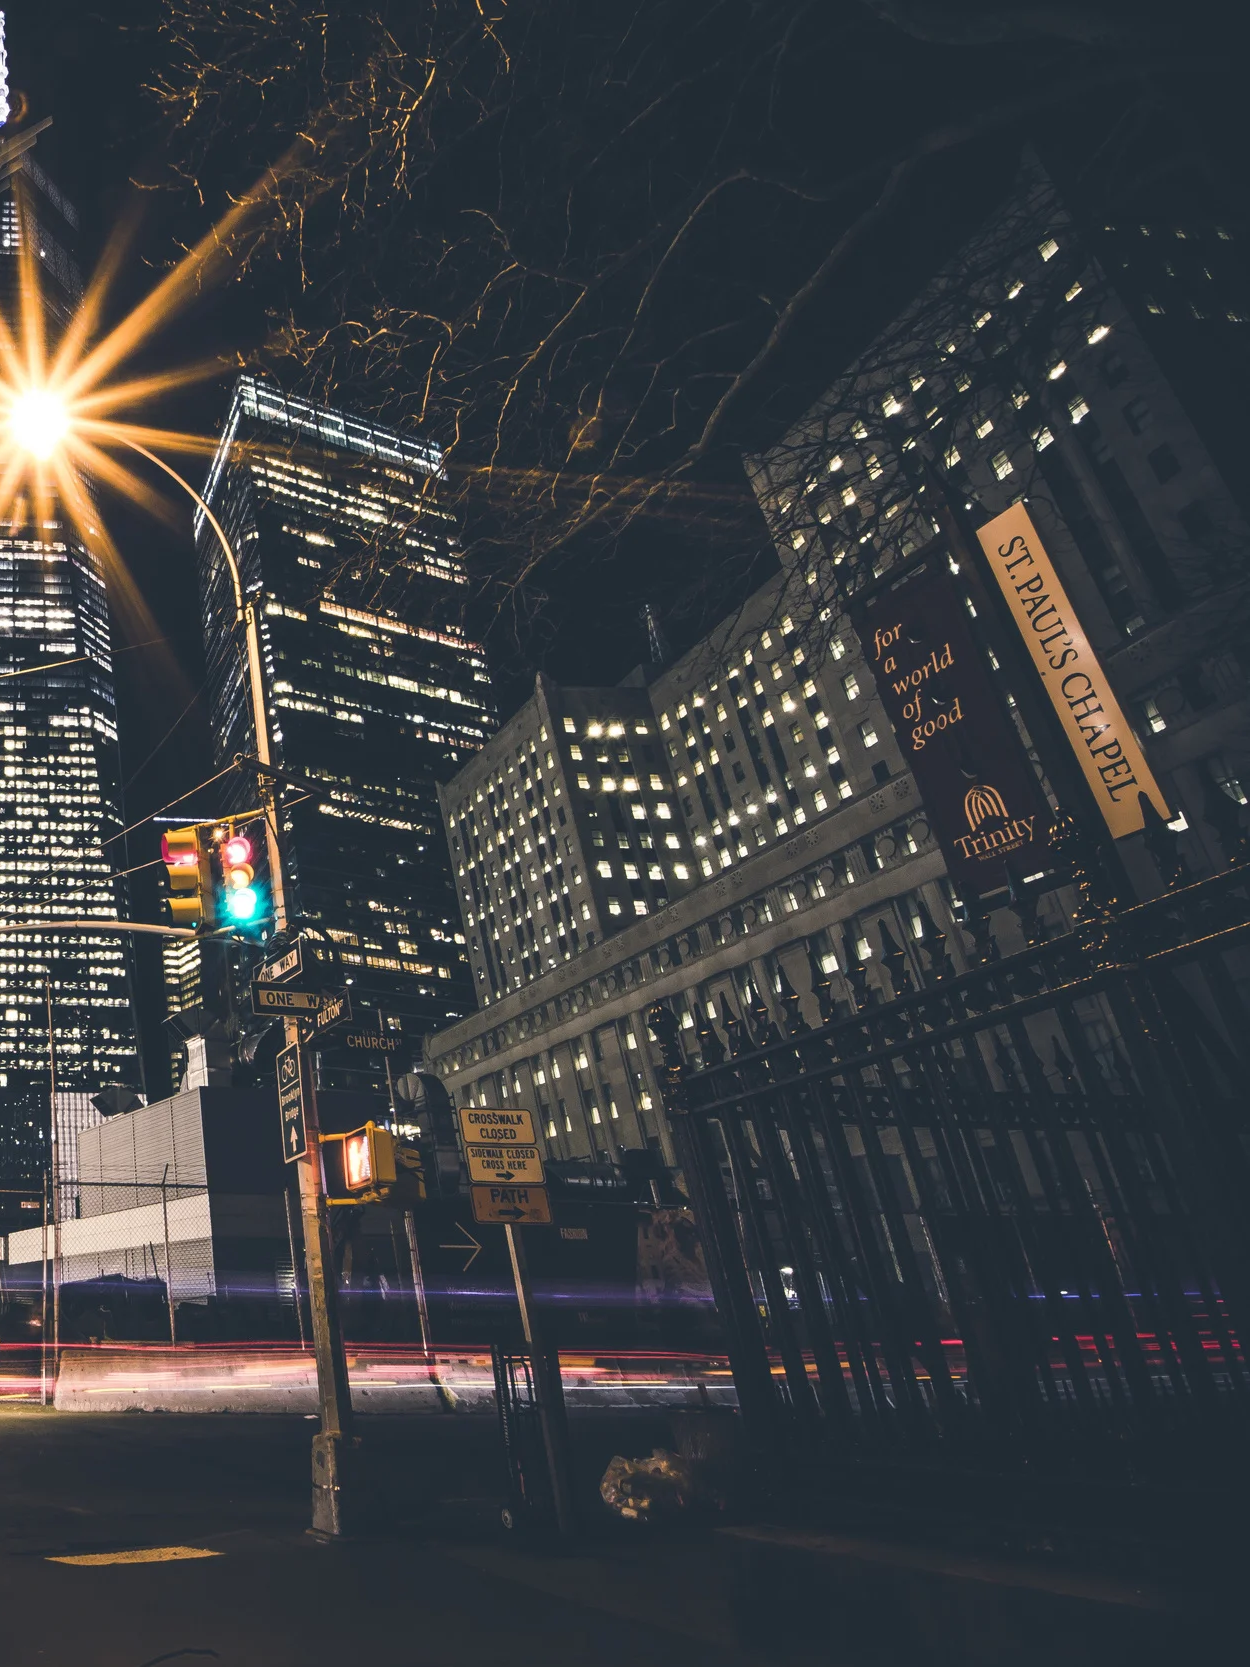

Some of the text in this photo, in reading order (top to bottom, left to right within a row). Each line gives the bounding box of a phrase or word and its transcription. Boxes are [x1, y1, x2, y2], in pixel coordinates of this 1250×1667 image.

[872, 623, 902, 660] for
[884, 655, 897, 674] a
[891, 642, 954, 696] world
[998, 535, 1139, 803] ST. PAUL'S CHAPEL
[902, 688, 922, 722] of
[910, 697, 965, 751] good
[953, 815, 1036, 860] Trinity
[977, 840, 1025, 862] WALL STREET
[260, 953, 294, 982] ONE WAY
[266, 991, 294, 1006] ONE
[317, 1003, 340, 1028] FULTON
[347, 1035, 395, 1051] CHURCH
[281, 1087, 301, 1107] Brooklyn
[285, 1106, 299, 1122] Bridge
[468, 1112, 524, 1126] CROSSWALK
[479, 1128, 517, 1140] CLOSED
[470, 1148, 535, 1159] SIDEWALK CLOSED
[481, 1160, 528, 1171] CROSS HERE
[490, 1188, 529, 1204] PATH
